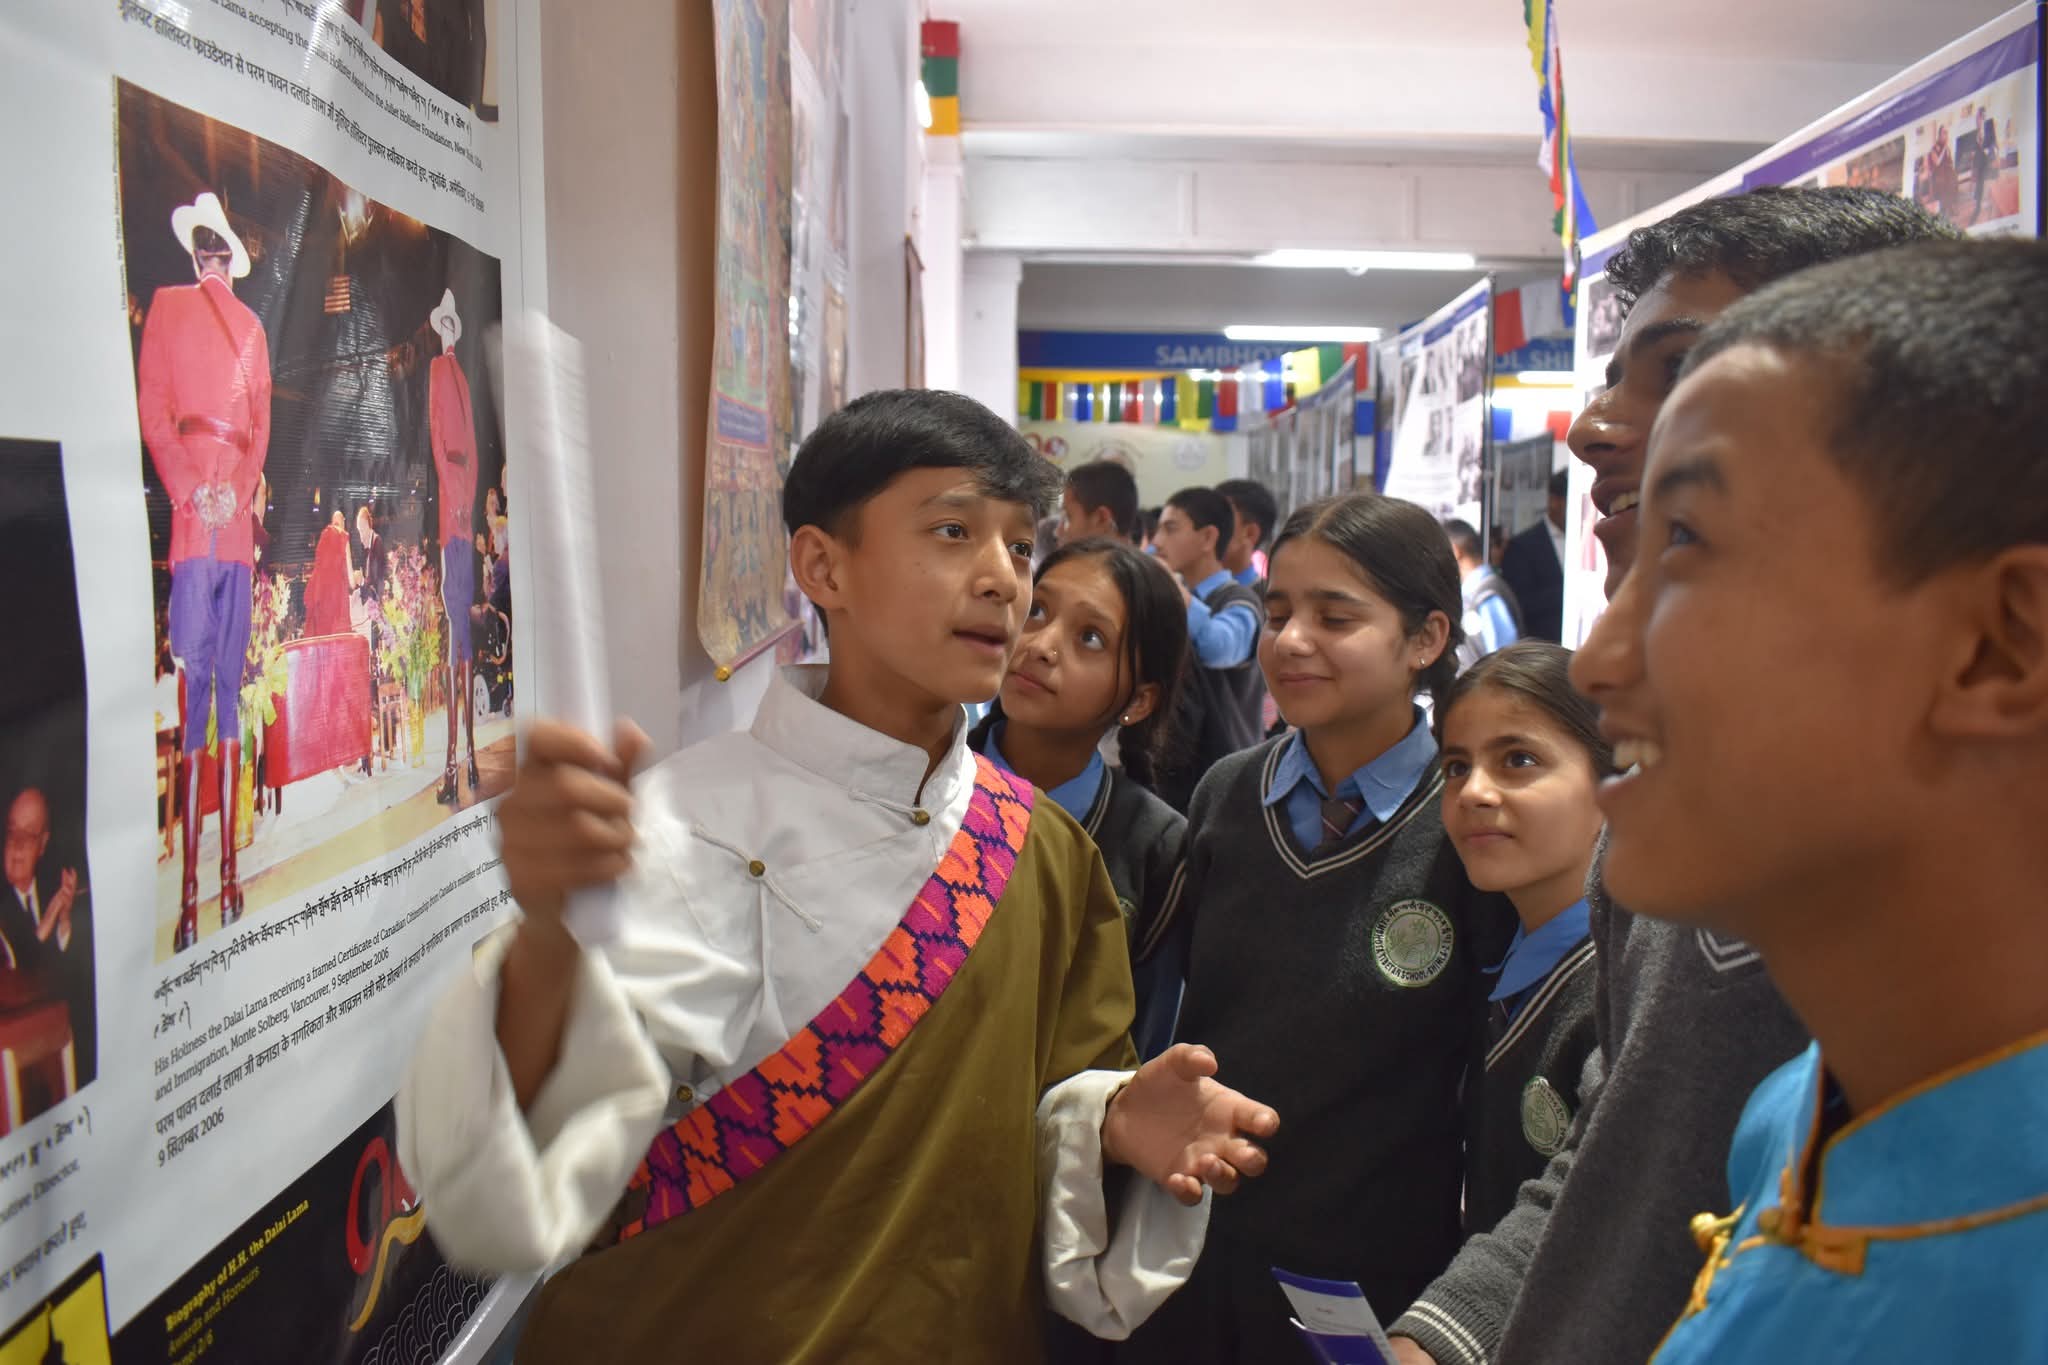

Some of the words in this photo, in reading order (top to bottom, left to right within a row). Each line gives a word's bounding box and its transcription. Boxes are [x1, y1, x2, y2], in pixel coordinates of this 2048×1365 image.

[235, 53, 244, 74] से
[245, 61, 265, 83] परम
[267, 71, 289, 94] पावन
[248, 11, 293, 45] accepting
[295, 32, 309, 50] the
[154, 1056, 169, 1076] His
[170, 1033, 207, 1064] Holiness
[208, 1022, 222, 1040] the
[223, 1007, 244, 1031] Dalai
[245, 997, 268, 1018] Lama
[269, 976, 305, 1004] receiving
[306, 973, 311, 983] a
[312, 955, 337, 980] framed
[337, 938, 372, 964] Certificate
[373, 931, 380, 945] of
[380, 918, 407, 941] Canadian
[155, 1077, 172, 1102] and
[173, 1045, 230, 1089] Immigration,
[230, 1027, 257, 1051] Monte
[257, 1007, 289, 1034] Solberg,
[291, 982, 331, 1013] Vancouver,
[331, 977, 337, 990] 9
[337, 958, 373, 987] September
[373, 947, 390, 967] 2006
[156, 1112, 174, 1135] परम
[175, 1095, 198, 1121] पावन
[198, 1074, 222, 1106] दलाई
[222, 1064, 243, 1091] लामा
[243, 1054, 255, 1076] जी
[255, 1041, 280, 1067] कनाडा
[280, 1034, 290, 1051] के
[290, 1015, 324, 1047] नागरिकता
[325, 1005, 338, 1024] और
[158, 1149, 165, 1168] 9
[166, 1123, 199, 1160] सितम्बर
[201, 1106, 224, 1137] 2006
[165, 1279, 217, 1331] Biography
[217, 1266, 228, 1285] of
[228, 1250, 249, 1276] H.H.
[249, 1238, 264, 1257] the
[264, 1219, 287, 1244] Dalai
[286, 1199, 310, 1225] Lama
